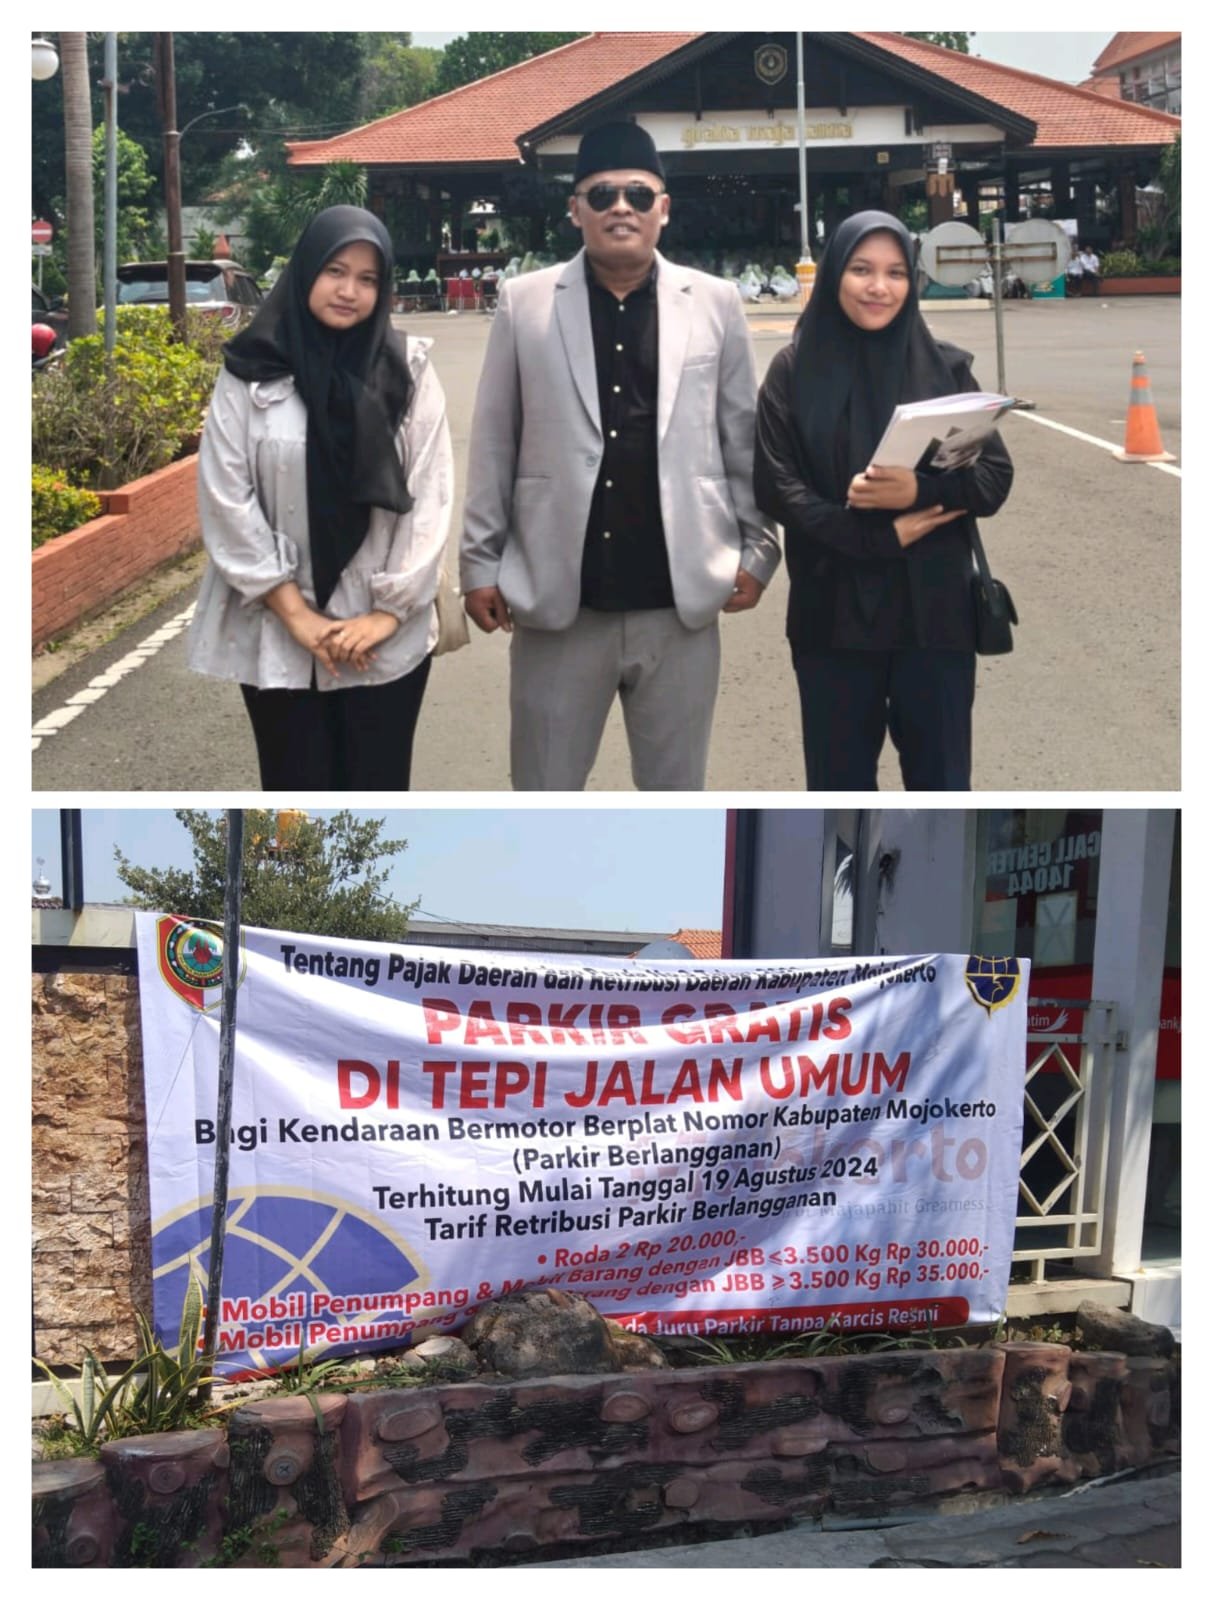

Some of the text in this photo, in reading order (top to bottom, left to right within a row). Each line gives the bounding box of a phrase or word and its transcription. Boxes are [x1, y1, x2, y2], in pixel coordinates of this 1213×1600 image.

[280, 944, 381, 987] Tentang
[388, 952, 451, 989] Pajak
[422, 996, 854, 1046] PARKIR GRATIS
[337, 1051, 912, 1110] DI TEPI JALAN UMUM
[194, 1097, 997, 1151] Bgi Kendaraan Bermotor Berplat Nomor Kabupaten Mojokerto
[512, 1135, 782, 1175] (Parkir Berlangganan)
[372, 1156, 878, 1212] Terhitung Mulai Tanggal 19 Agustus 2024
[424, 1212, 488, 1241] Tarif
[495, 1207, 611, 1238] Retribusi
[618, 1201, 687, 1229] Parkir
[691, 1190, 837, 1222] Berlangganan
[554, 1228, 748, 1268] Roda 2 Rp 20.000,-
[222, 1294, 304, 1323] Mobil
[313, 1288, 470, 1316] Penumpang
[476, 1281, 495, 1300] &
[567, 1265, 643, 1286] Barang
[648, 1256, 720, 1278] dengan
[724, 1247, 766, 1268] JBB
[855, 1244, 881, 1267] Kg
[886, 1242, 911, 1265] Rp
[916, 1237, 989, 1260] 30.000,-
[219, 1322, 301, 1351] Mobil
[310, 1310, 458, 1345] Penumpang
[636, 1278, 716, 1299] dengan
[722, 1274, 766, 1293] JBB
[789, 1269, 850, 1290] 3.500
[855, 1268, 881, 1291] Kg
[886, 1267, 911, 1290] Rp
[916, 1261, 990, 1283] 35.000,-
[653, 1320, 699, 1337] Juru
[704, 1314, 766, 1336] Parkir
[769, 1314, 824, 1334] Tanpa
[829, 1307, 884, 1329] Karcis
[888, 1303, 940, 1325] Resmi
